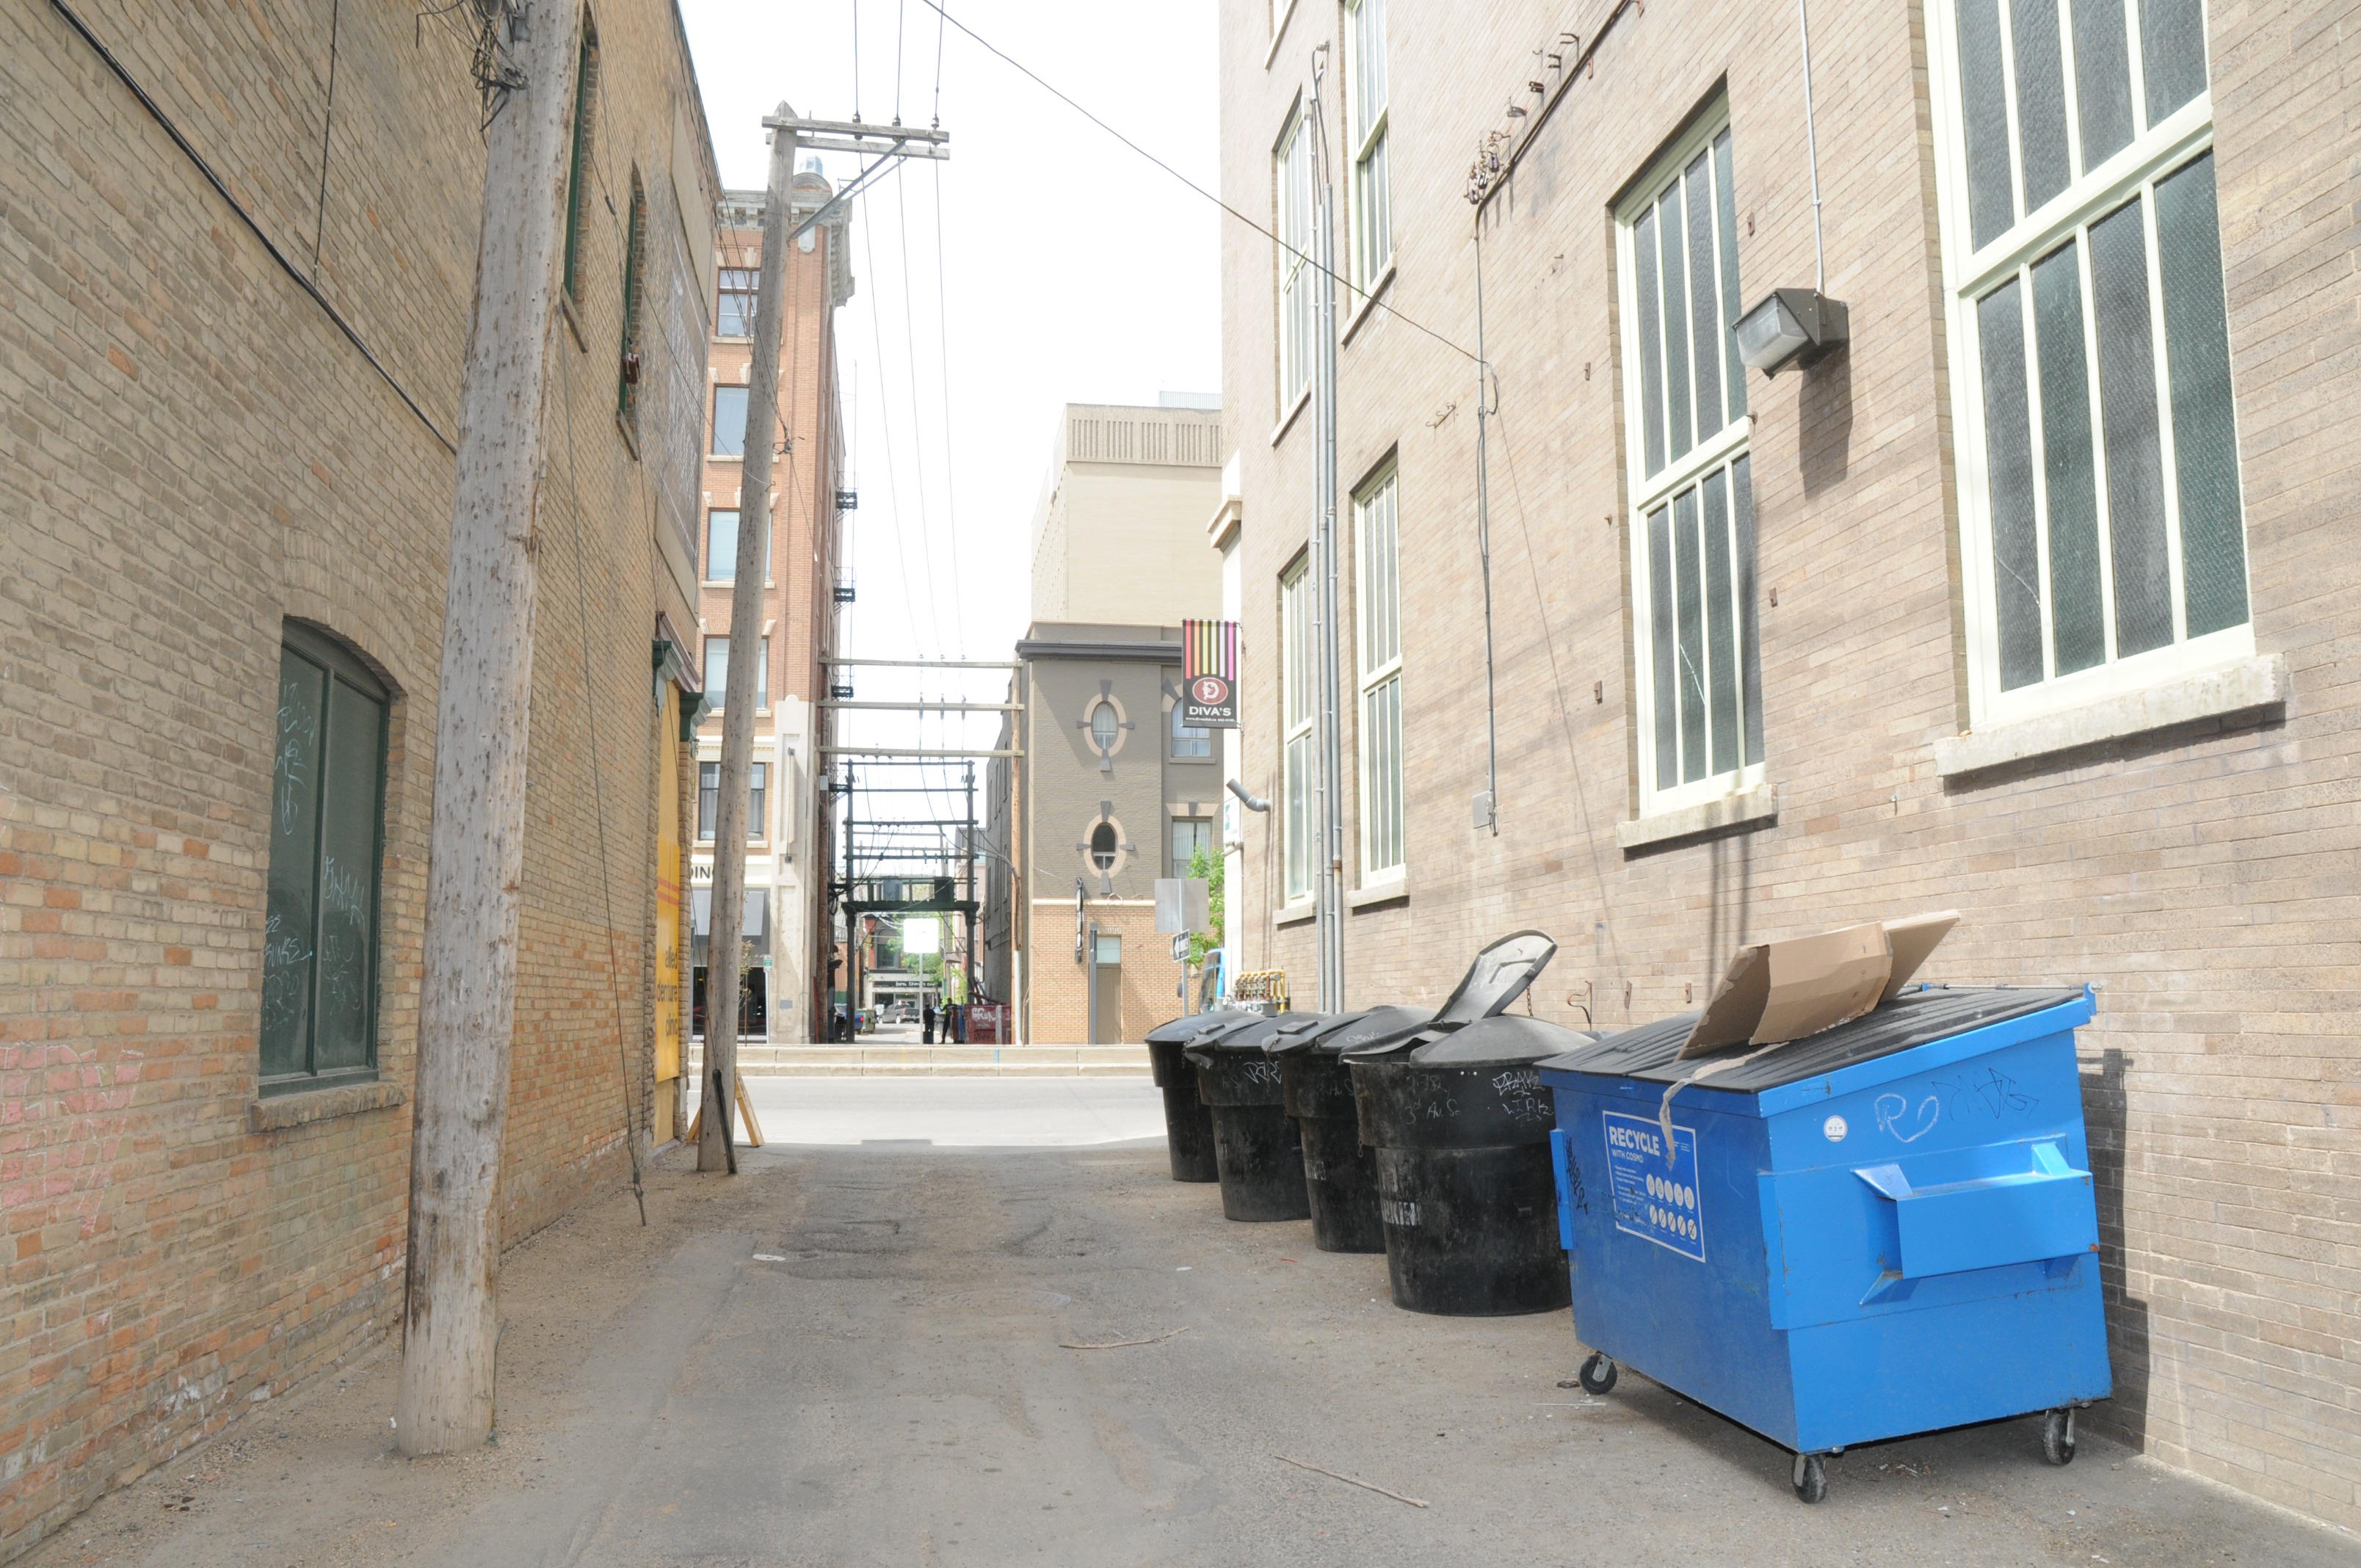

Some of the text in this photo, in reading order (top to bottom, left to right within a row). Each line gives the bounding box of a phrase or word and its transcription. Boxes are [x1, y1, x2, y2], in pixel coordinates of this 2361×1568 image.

[1189, 705, 1232, 716] DIVA'S
[1609, 1125, 1661, 1157] RECYCLE
[1611, 1148, 1644, 1164] WITH COSMO
